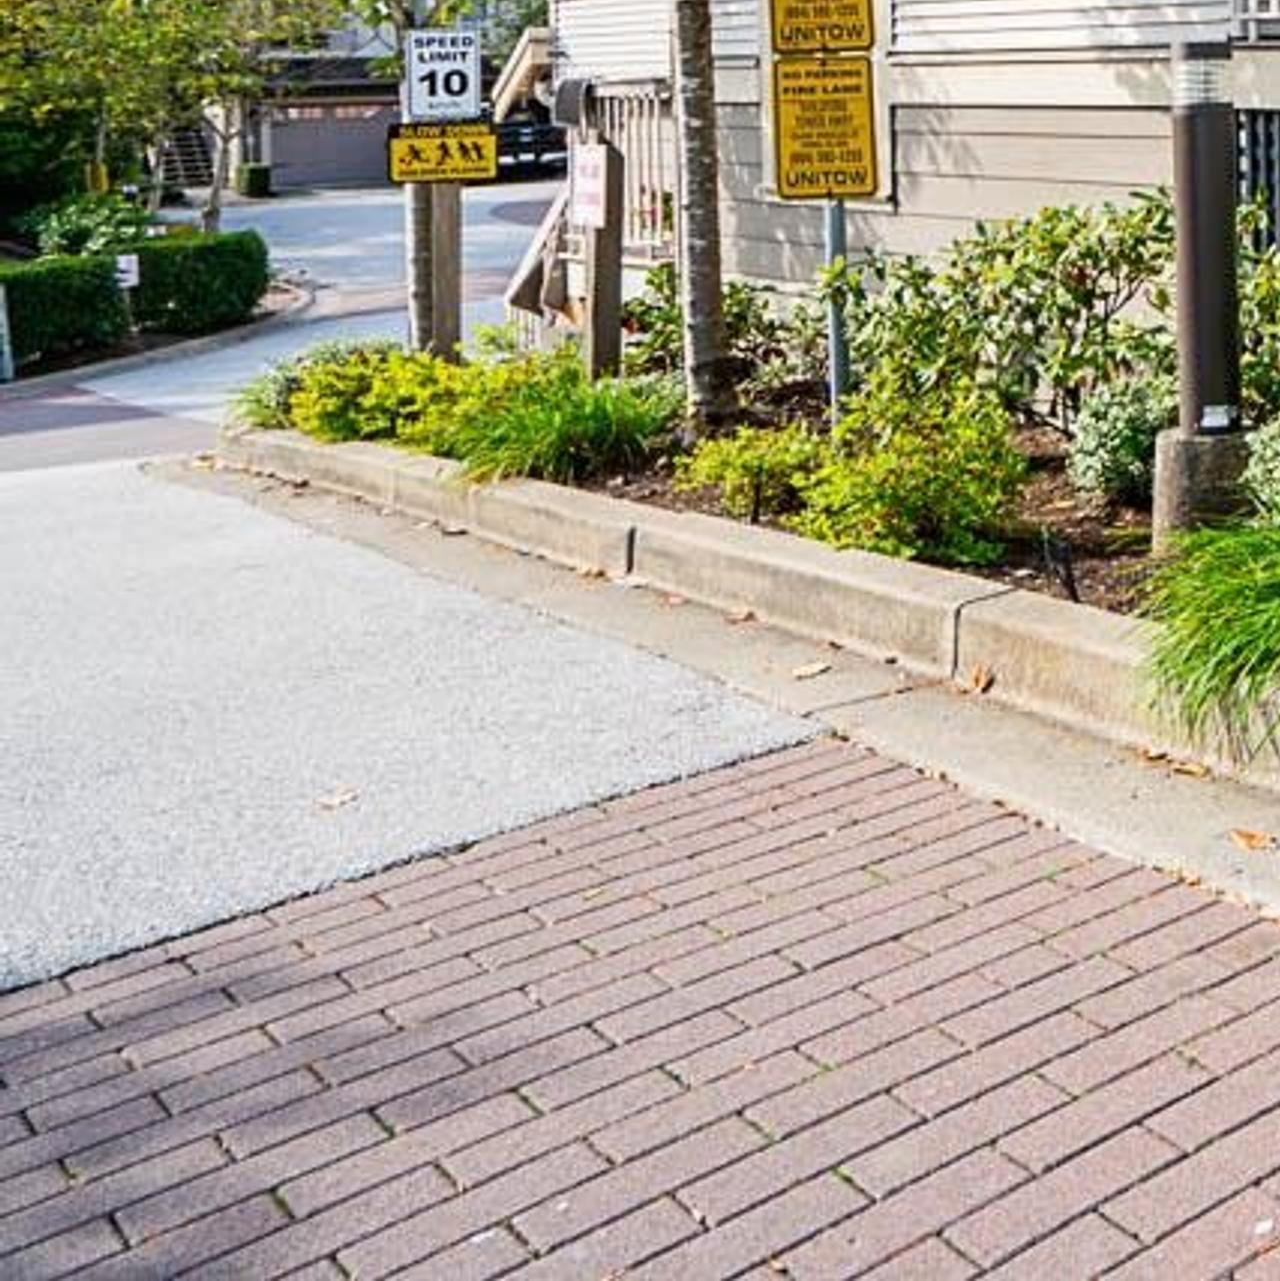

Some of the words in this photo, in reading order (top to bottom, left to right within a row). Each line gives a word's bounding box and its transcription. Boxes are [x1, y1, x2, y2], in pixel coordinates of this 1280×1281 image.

[780, 22, 865, 41] UNITOW
[414, 36, 474, 49] SPEED
[418, 51, 468, 64] LIMIT
[804, 67, 863, 79] PARKING
[419, 69, 468, 97] 10
[783, 85, 817, 95] FIRE
[822, 82, 863, 94] LANE
[786, 166, 868, 187] UNITOW
